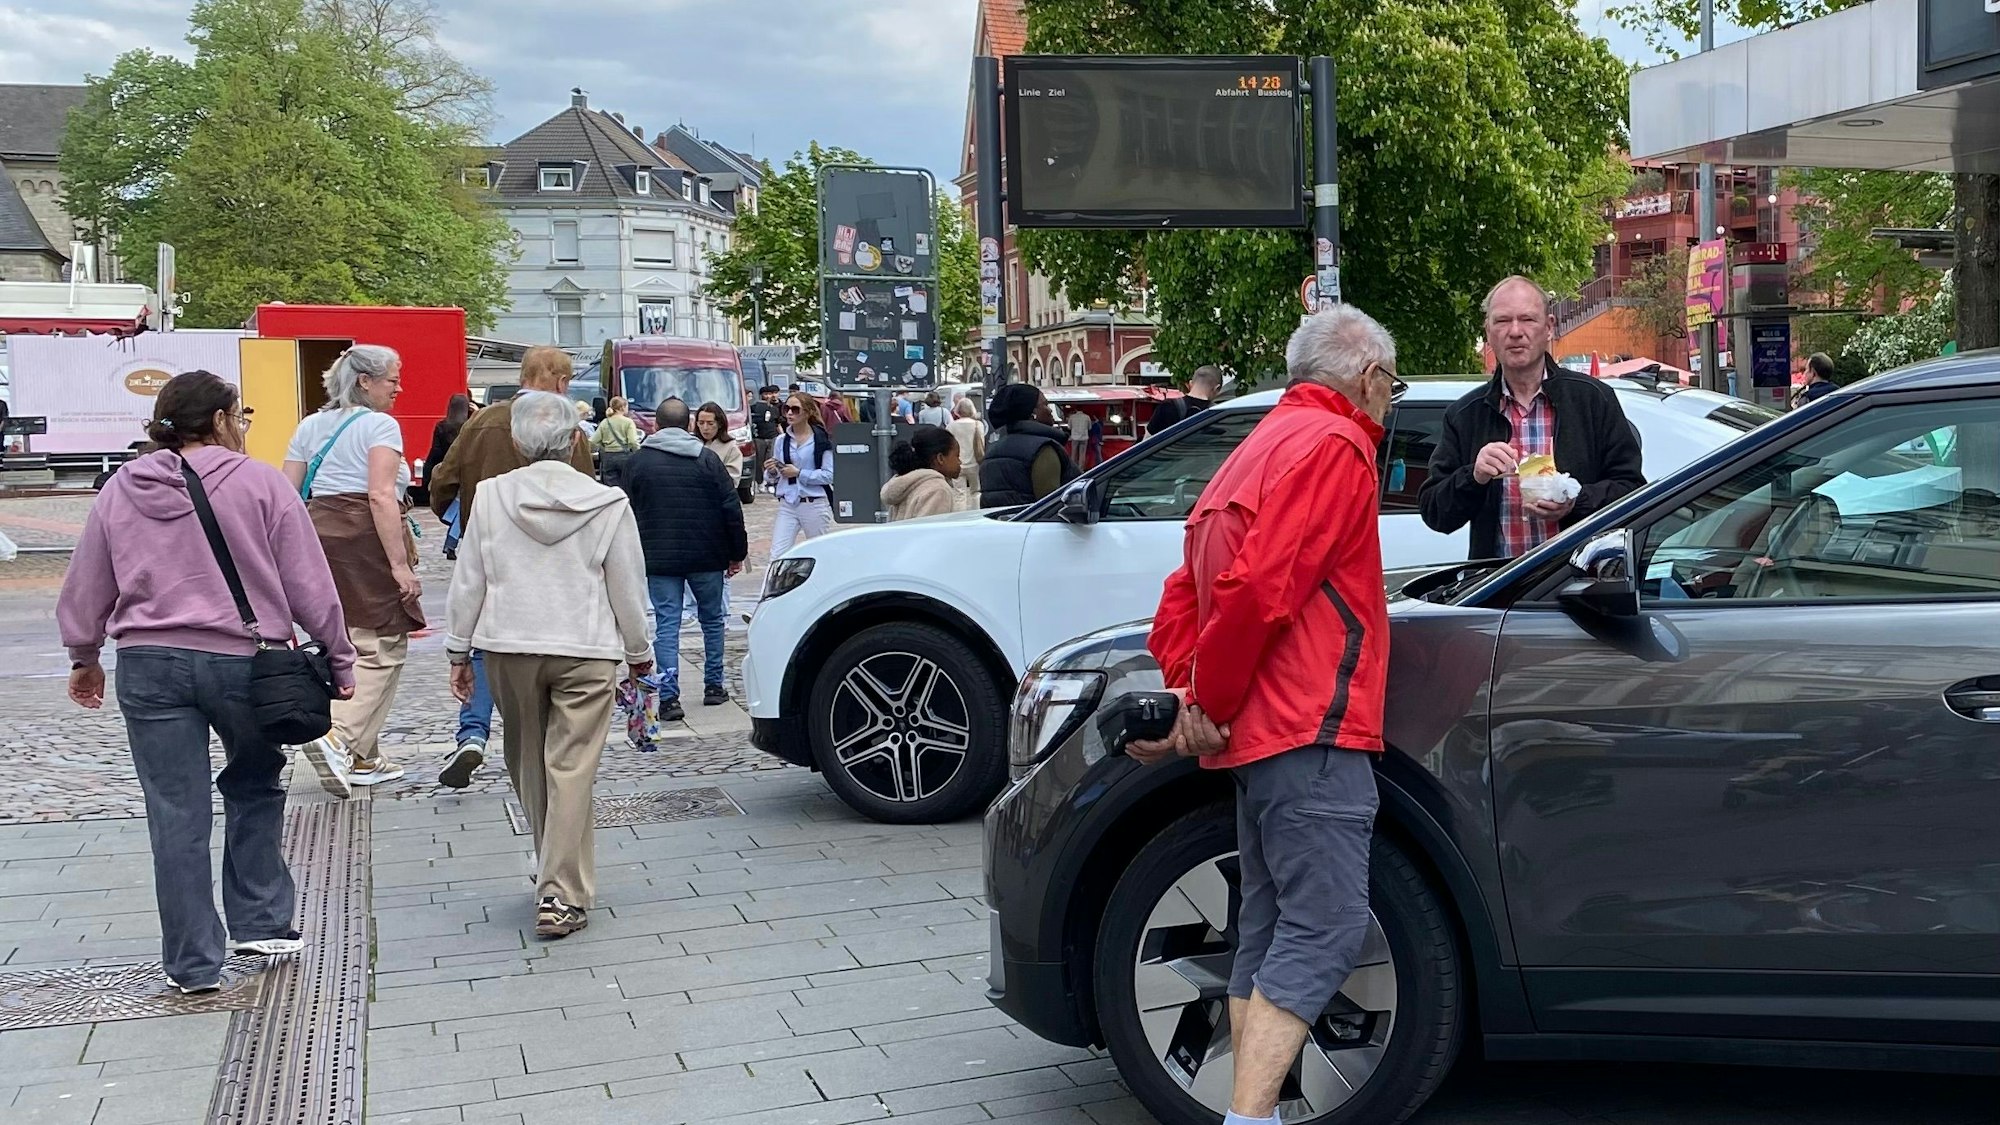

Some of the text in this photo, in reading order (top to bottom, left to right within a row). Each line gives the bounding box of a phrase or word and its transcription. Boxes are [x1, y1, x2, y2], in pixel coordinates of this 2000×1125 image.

[1238, 76, 1281, 89] 14 28
[1018, 88, 1066, 97] Linie Ziel
[1215, 88, 1293, 98] Abfahrt Bussteig
[739, 347, 791, 360] Backfisch
